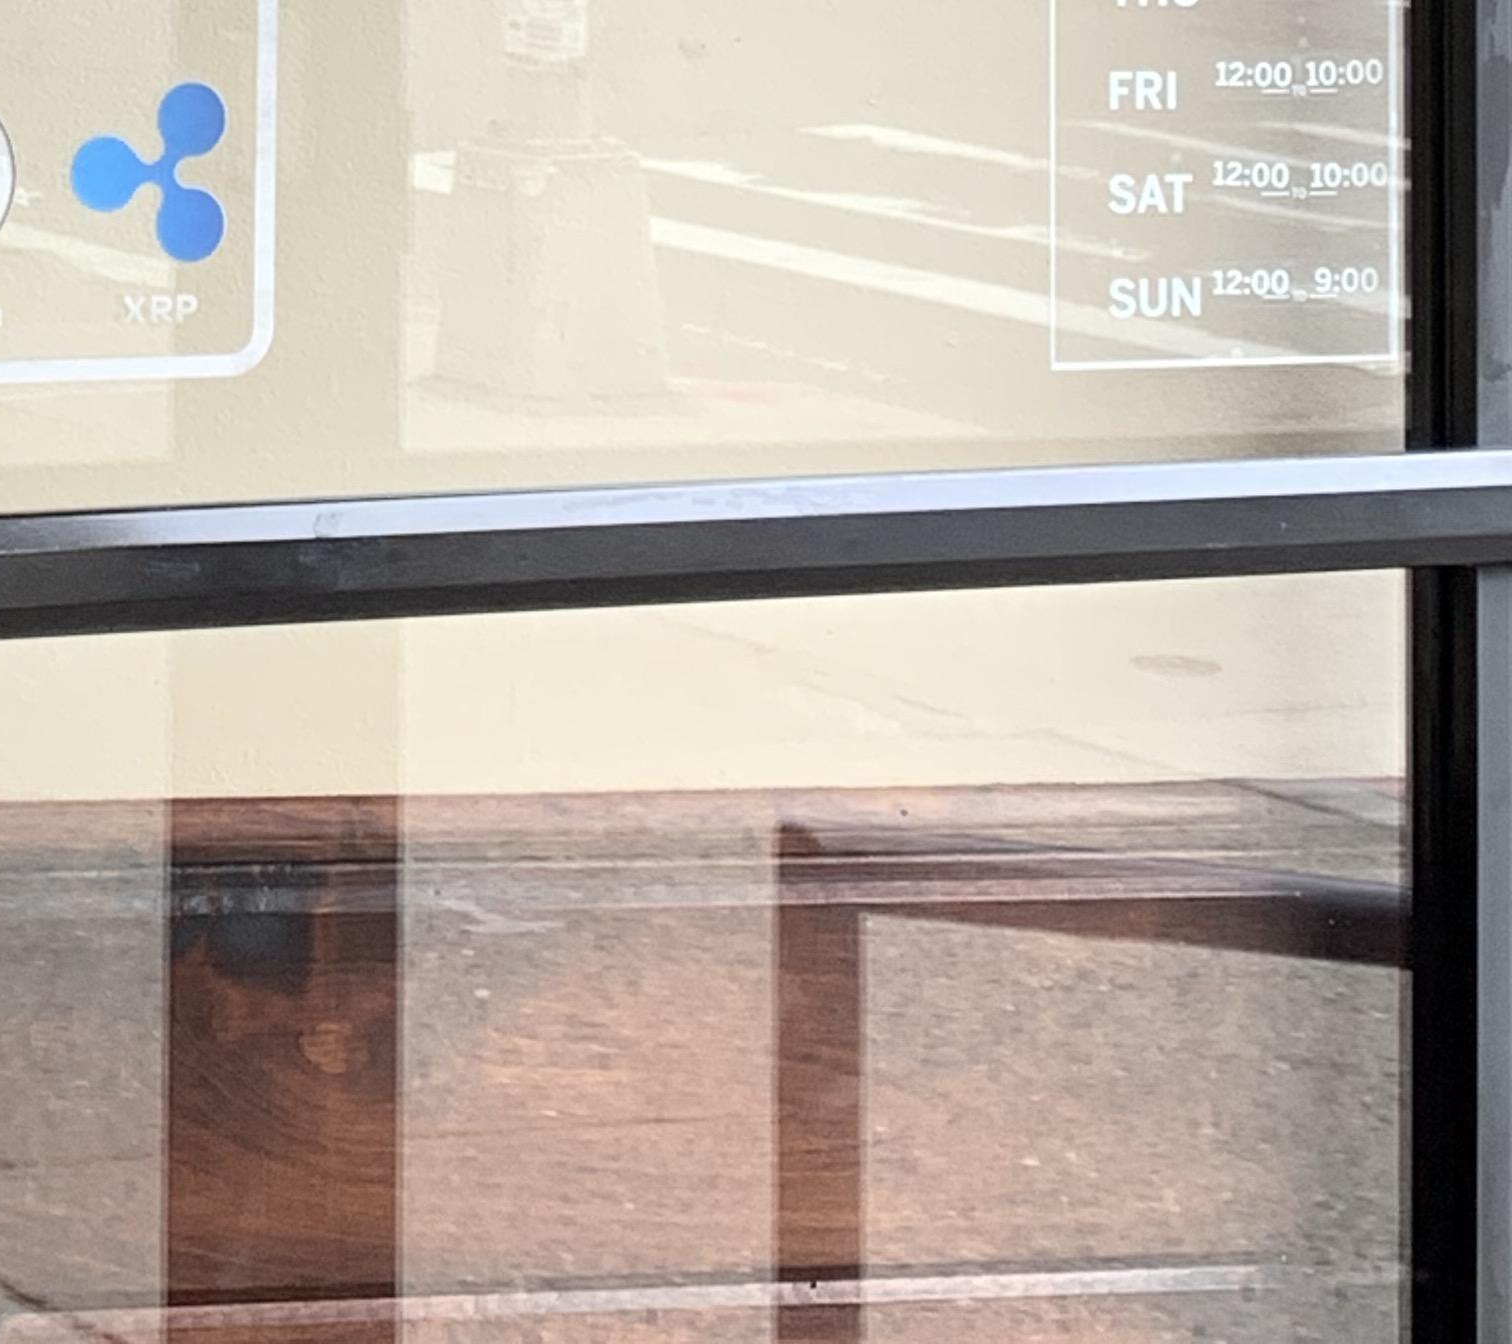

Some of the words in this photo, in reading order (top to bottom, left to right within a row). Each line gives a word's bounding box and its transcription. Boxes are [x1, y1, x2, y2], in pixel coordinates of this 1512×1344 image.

[1108, 71, 1178, 110] FRI
[1215, 61, 1291, 86] 12:00
[1306, 59, 1383, 85] 10:00
[1108, 174, 1192, 213] SAT
[1213, 162, 1289, 187] 12:00
[1310, 162, 1387, 187] 10:00
[123, 294, 199, 325] XRP
[1108, 277, 1202, 318] SUN
[1212, 269, 1289, 294] 12:00
[1314, 268, 1379, 293] 9:00
